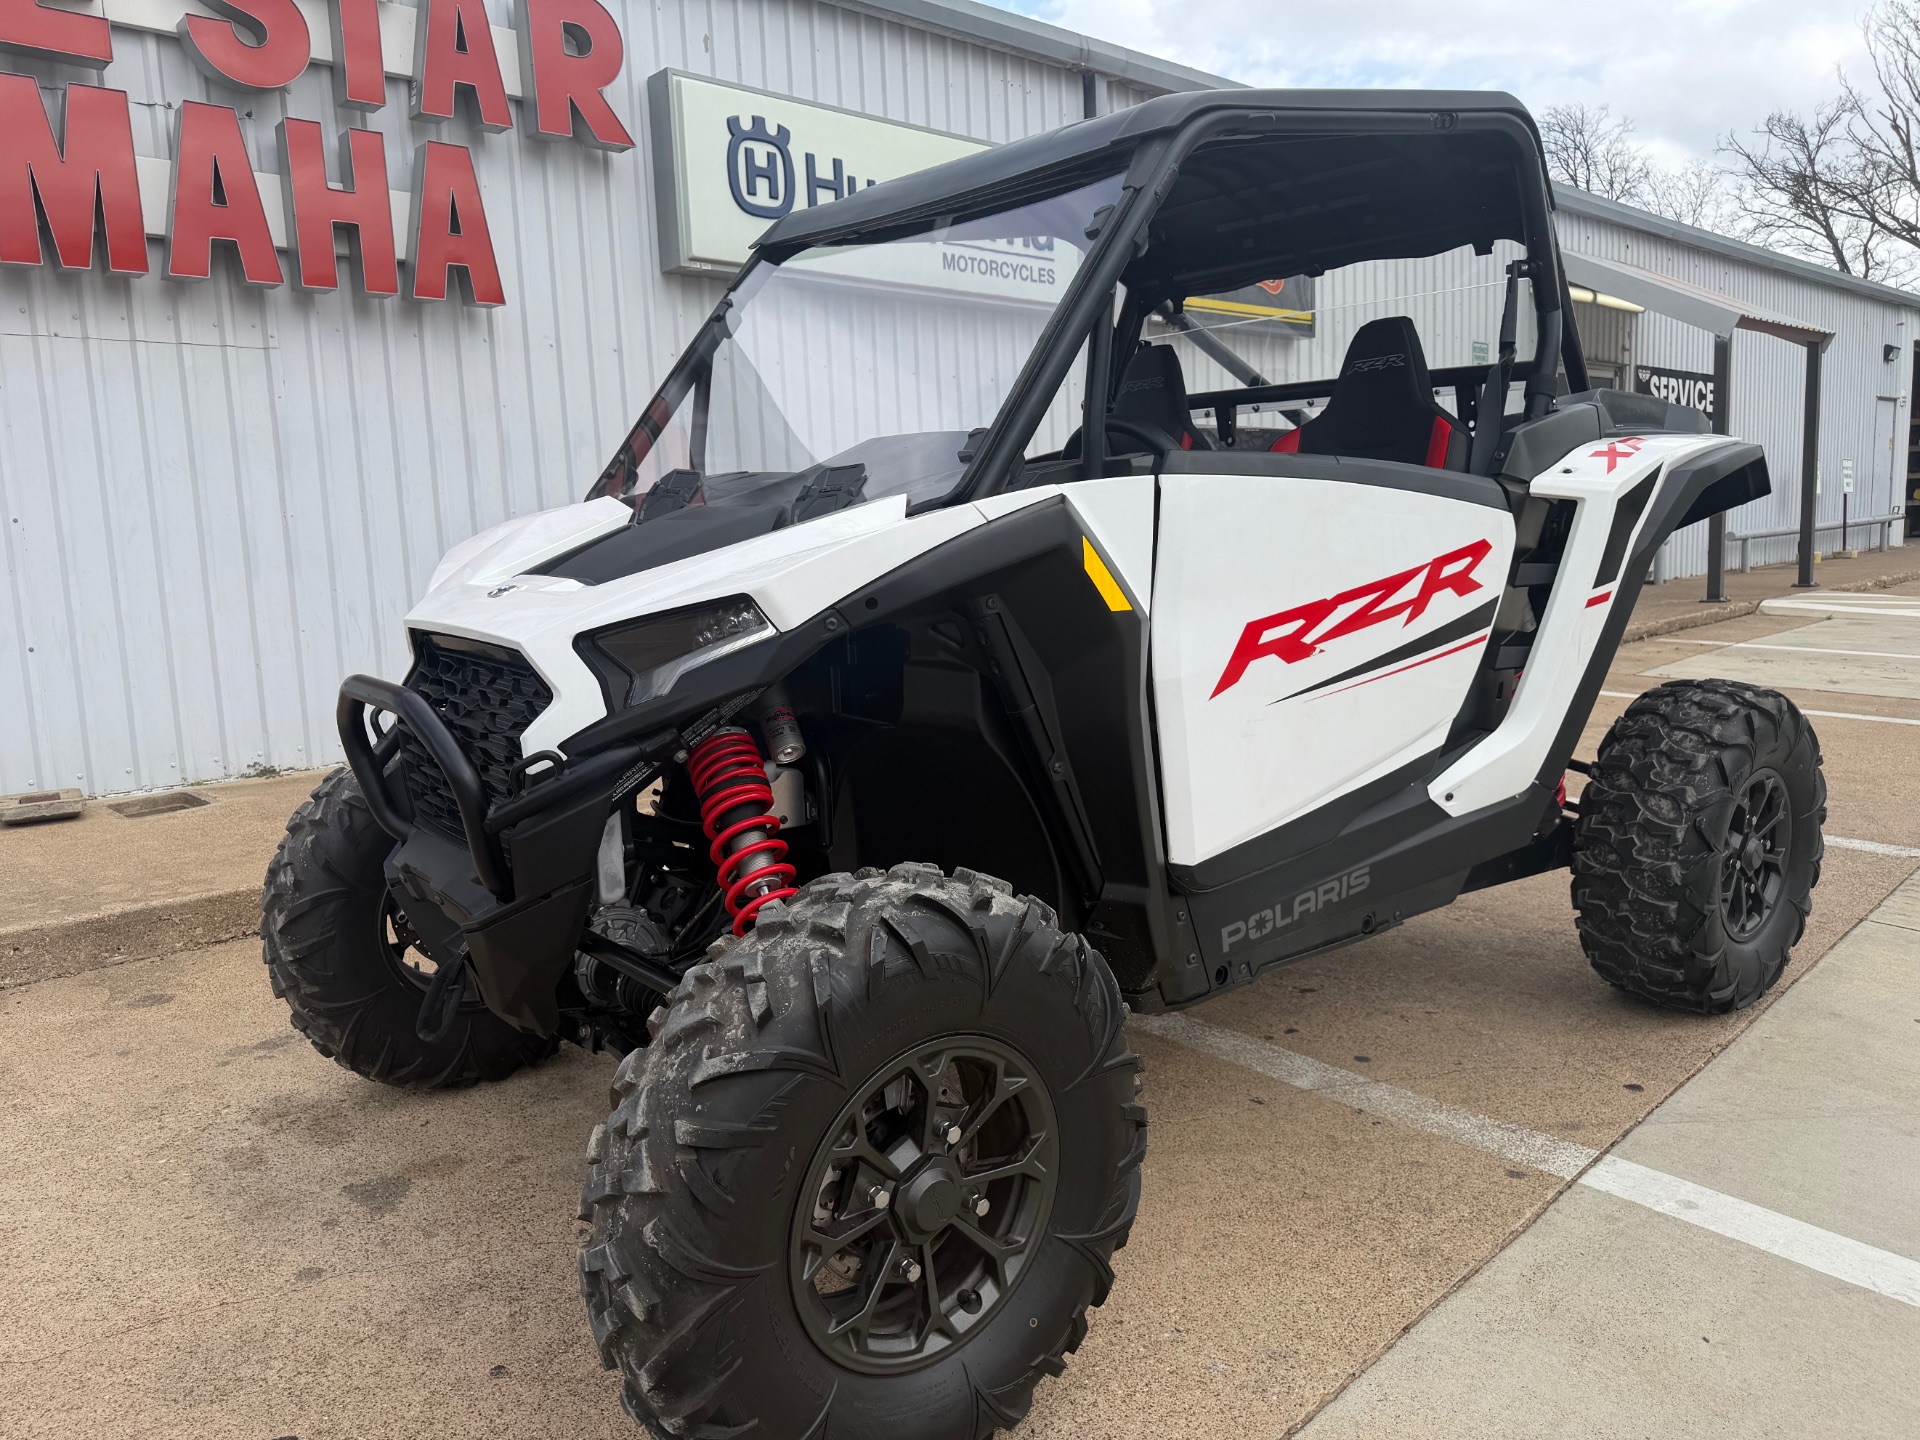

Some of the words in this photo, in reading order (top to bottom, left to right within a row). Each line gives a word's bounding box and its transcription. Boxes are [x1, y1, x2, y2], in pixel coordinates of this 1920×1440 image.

[744, 146, 779, 200] H
[942, 252, 1056, 285] MOTORCYCLES
[1346, 353, 1406, 376] RZR
[1649, 374, 1715, 413] SERVICE
[1588, 436, 1648, 475] XP
[1208, 538, 1493, 702] RZR
[689, 723, 717, 746] POLARIS
[1221, 865, 1371, 953] POLARIS
